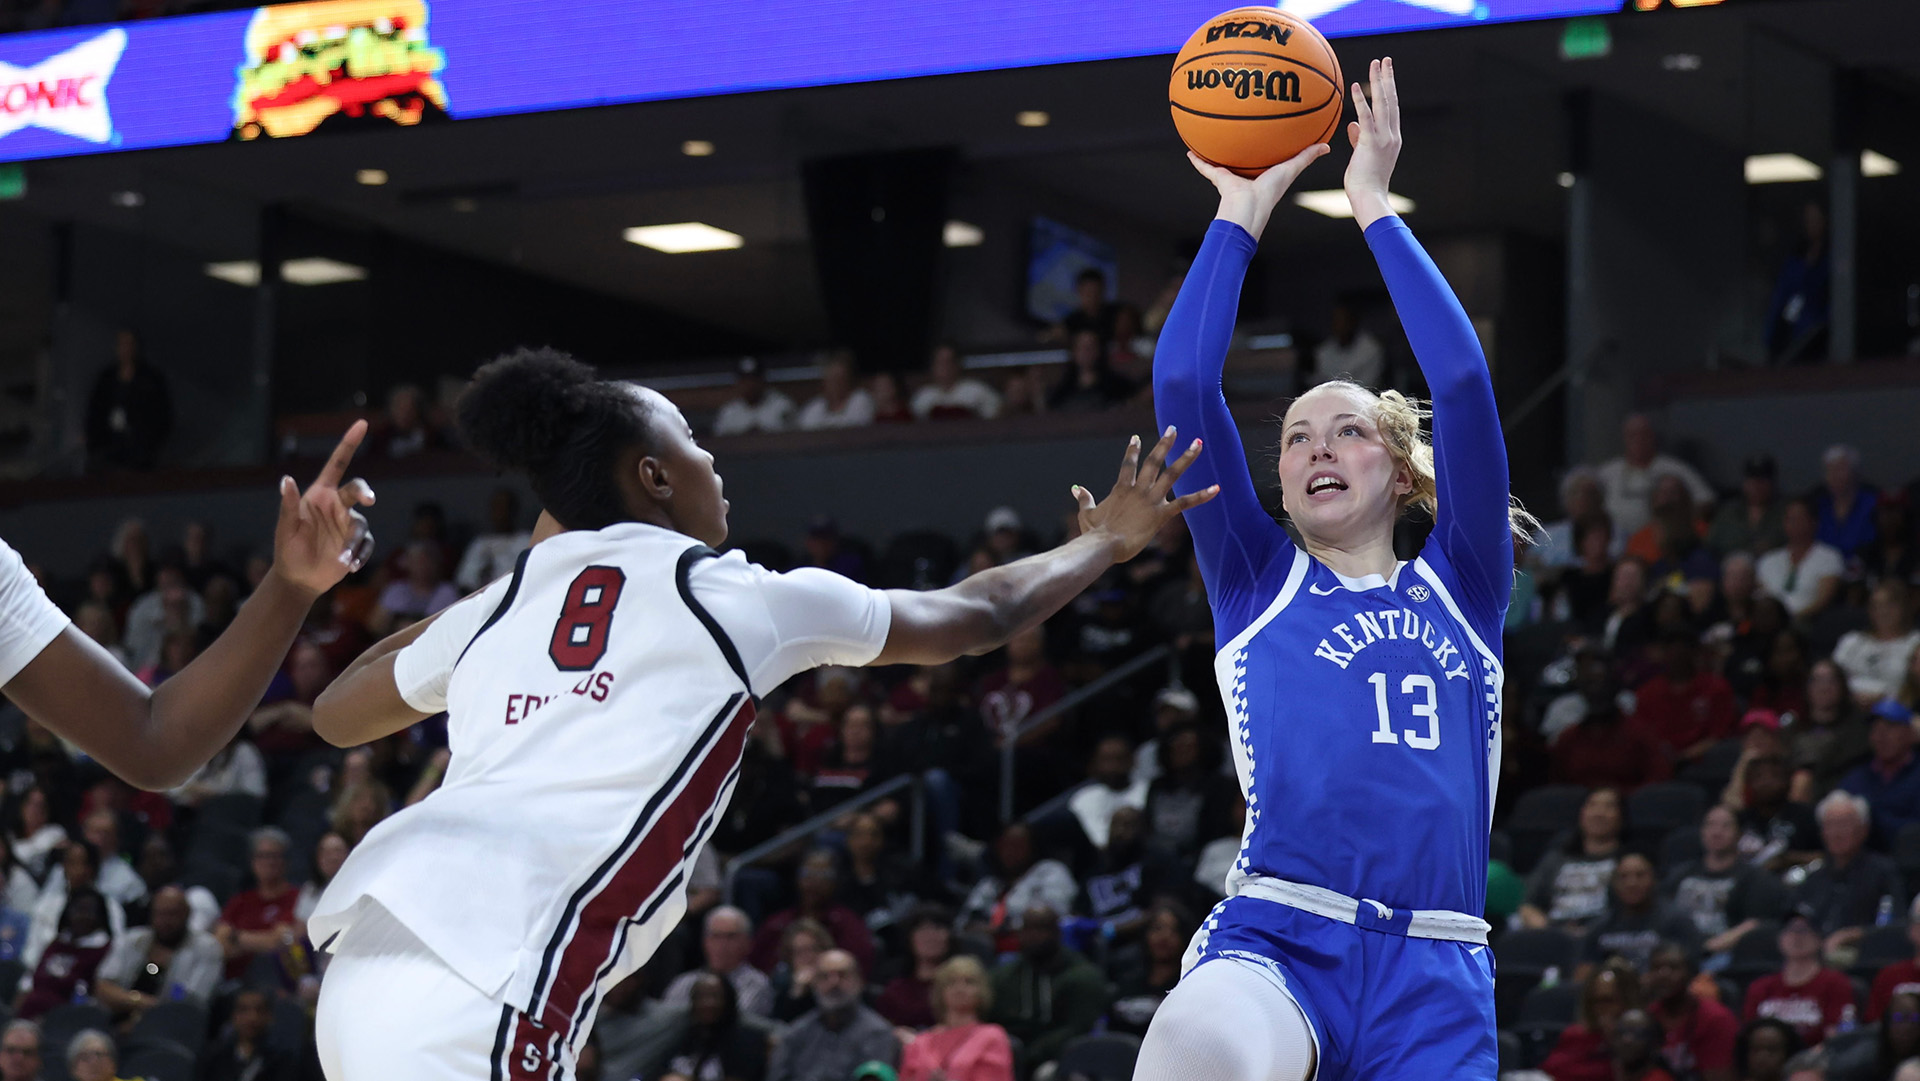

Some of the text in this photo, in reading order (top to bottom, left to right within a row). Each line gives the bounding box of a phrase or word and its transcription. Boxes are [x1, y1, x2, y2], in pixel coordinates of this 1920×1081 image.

[1206, 21, 1294, 46] NCAA
[0, 75, 96, 113] ONIC
[1187, 68, 1302, 103] Wilson
[1407, 586, 1428, 601] SEC
[548, 565, 626, 671] 8
[1314, 607, 1470, 680] KENTUCKY
[1368, 672, 1440, 750] 13
